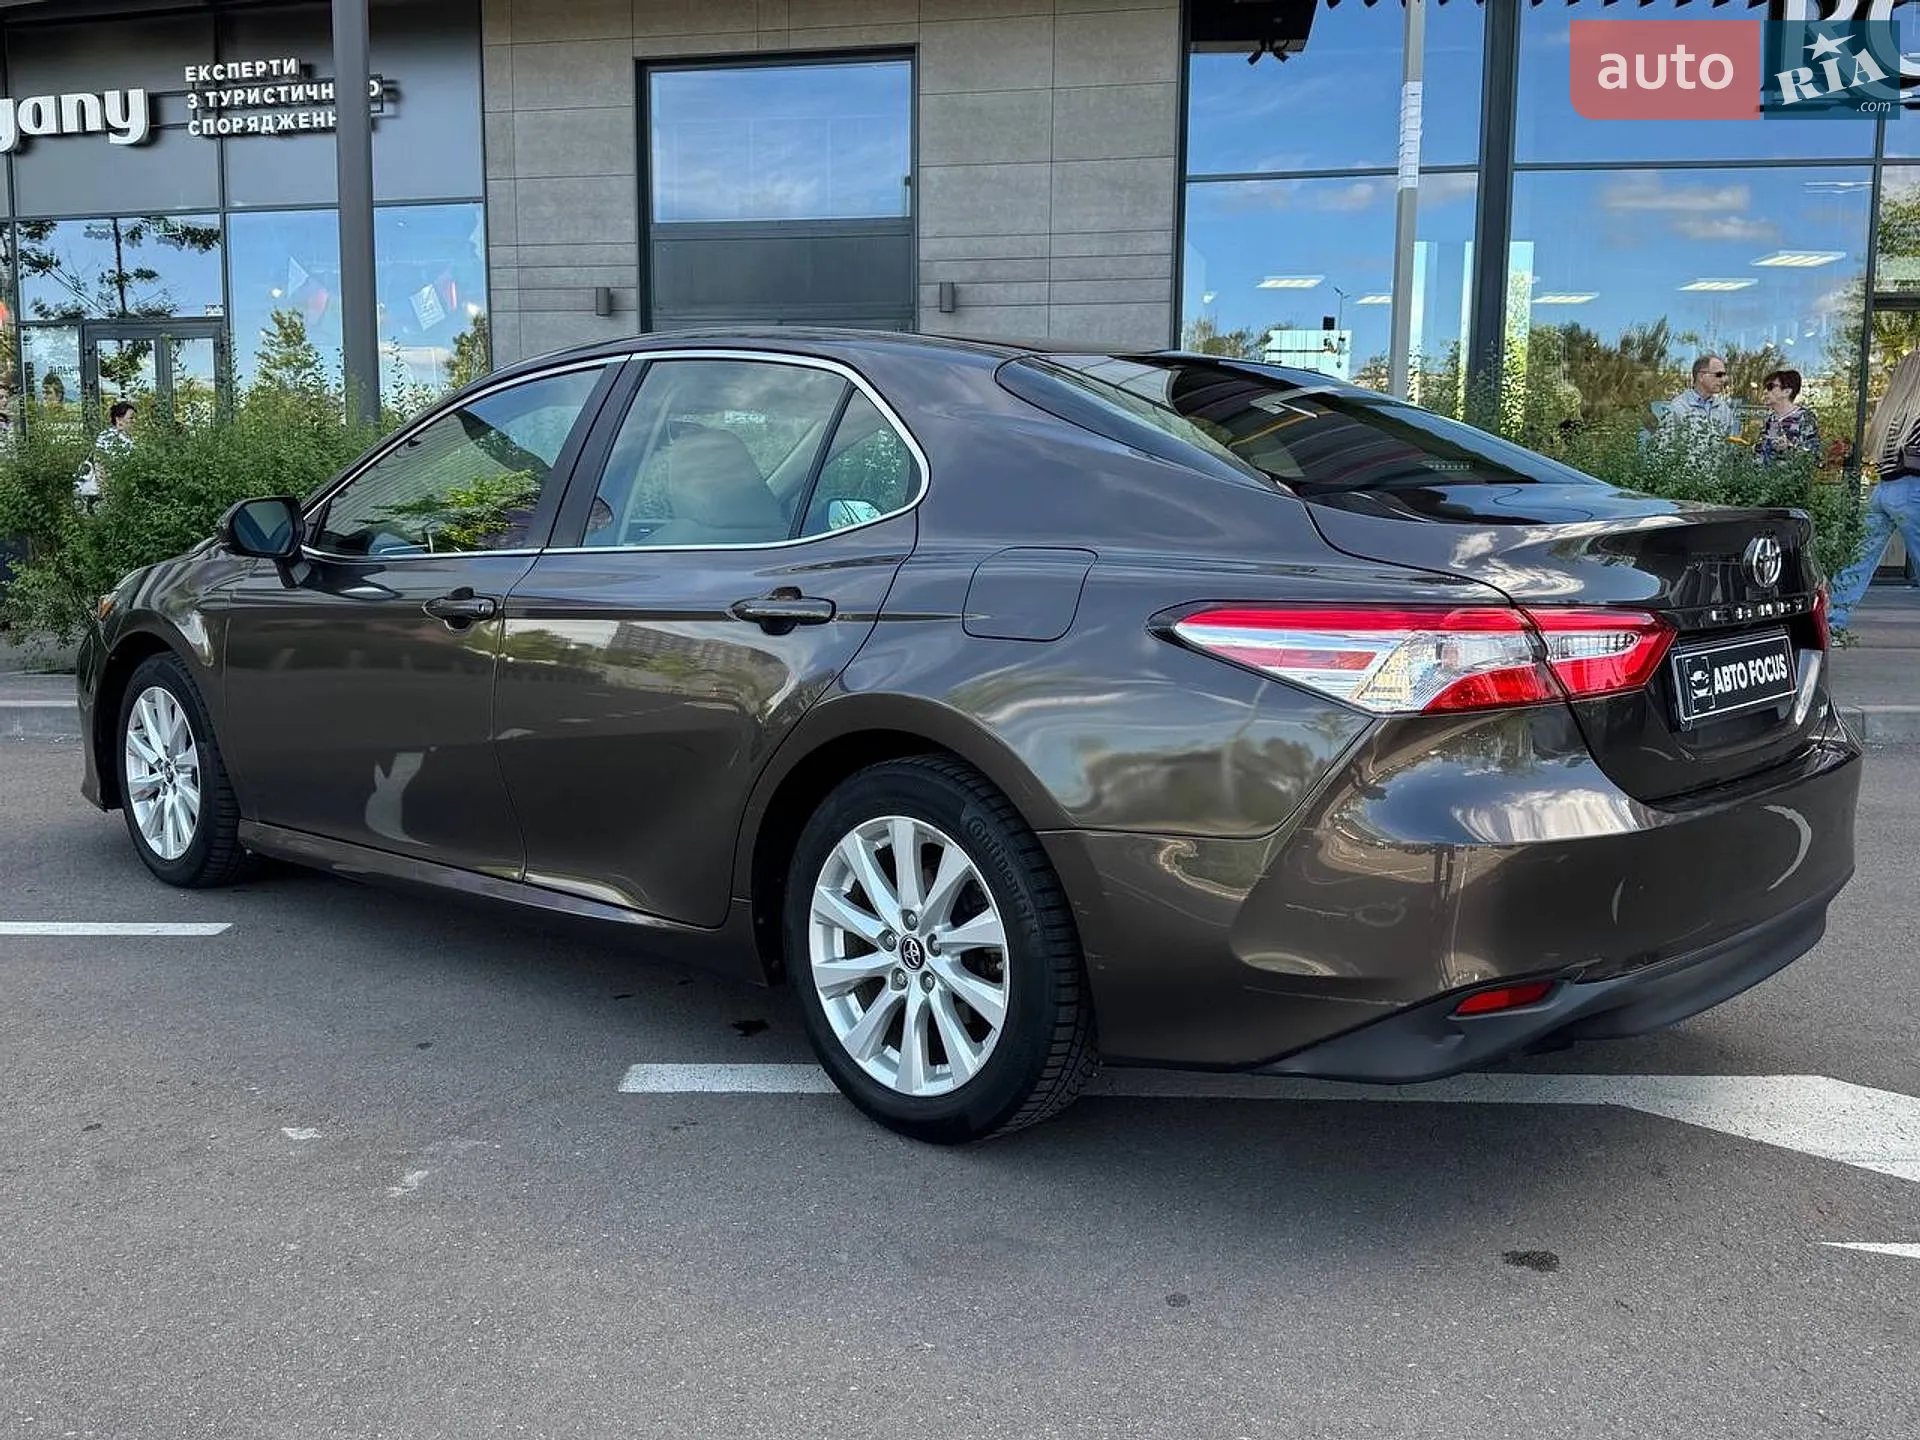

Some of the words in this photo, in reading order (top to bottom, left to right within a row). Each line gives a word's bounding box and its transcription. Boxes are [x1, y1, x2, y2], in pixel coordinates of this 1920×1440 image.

[185, 58, 297, 82] ЕКСПЕРТИ
[206, 79, 380, 108] ТУРИСТИЧНО
[188, 111, 337, 137] СПОРЯДЖЕНН
[1748, 653, 1788, 686] FOCUS
